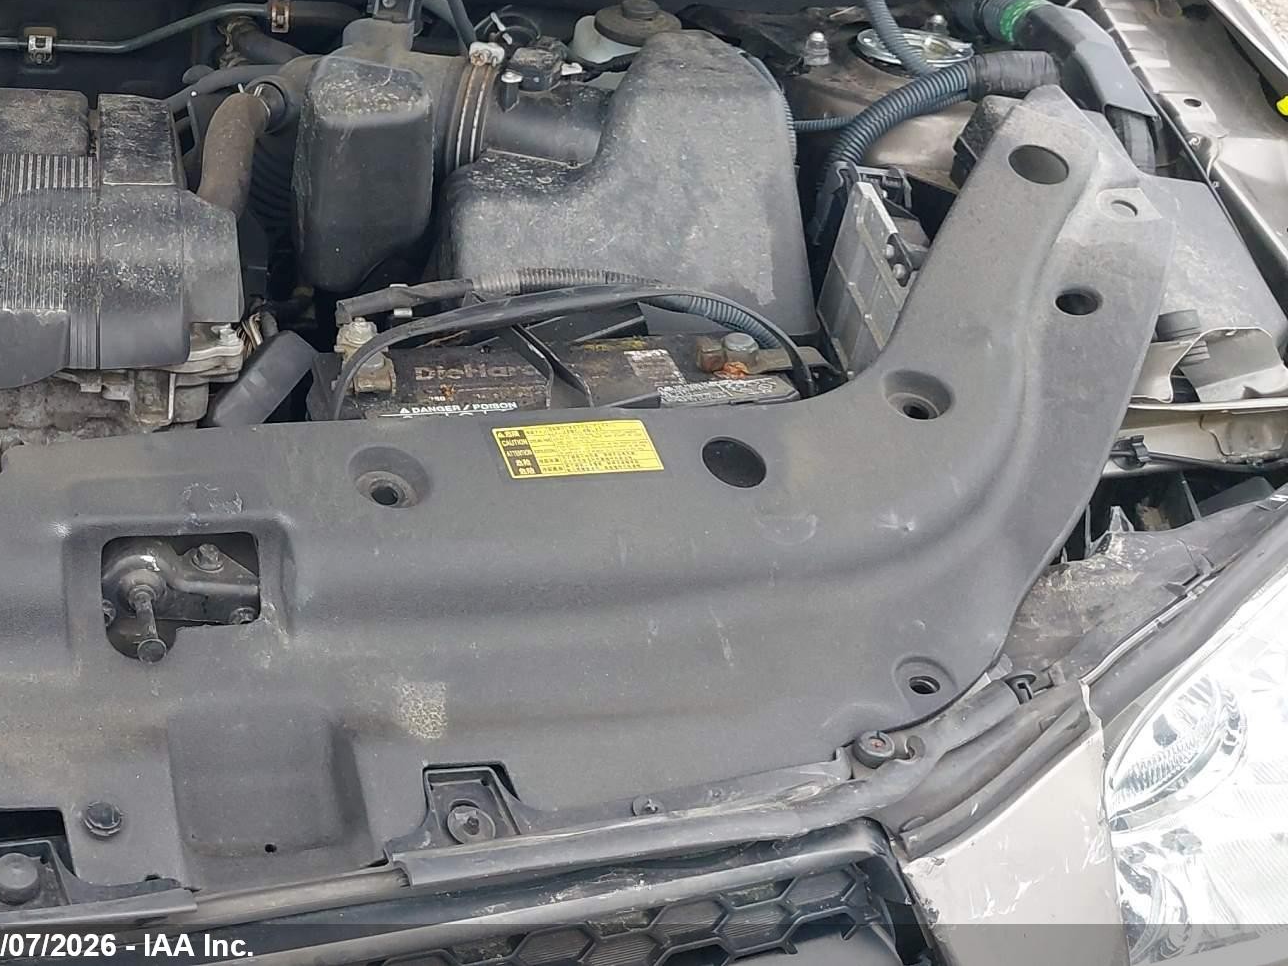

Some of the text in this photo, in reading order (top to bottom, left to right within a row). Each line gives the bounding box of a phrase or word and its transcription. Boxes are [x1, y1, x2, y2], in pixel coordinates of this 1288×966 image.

[412, 404, 462, 414] DANGER
[473, 401, 518, 411] POISON
[502, 438, 528, 446] CAUTION
[507, 449, 534, 457] ATTENTION
